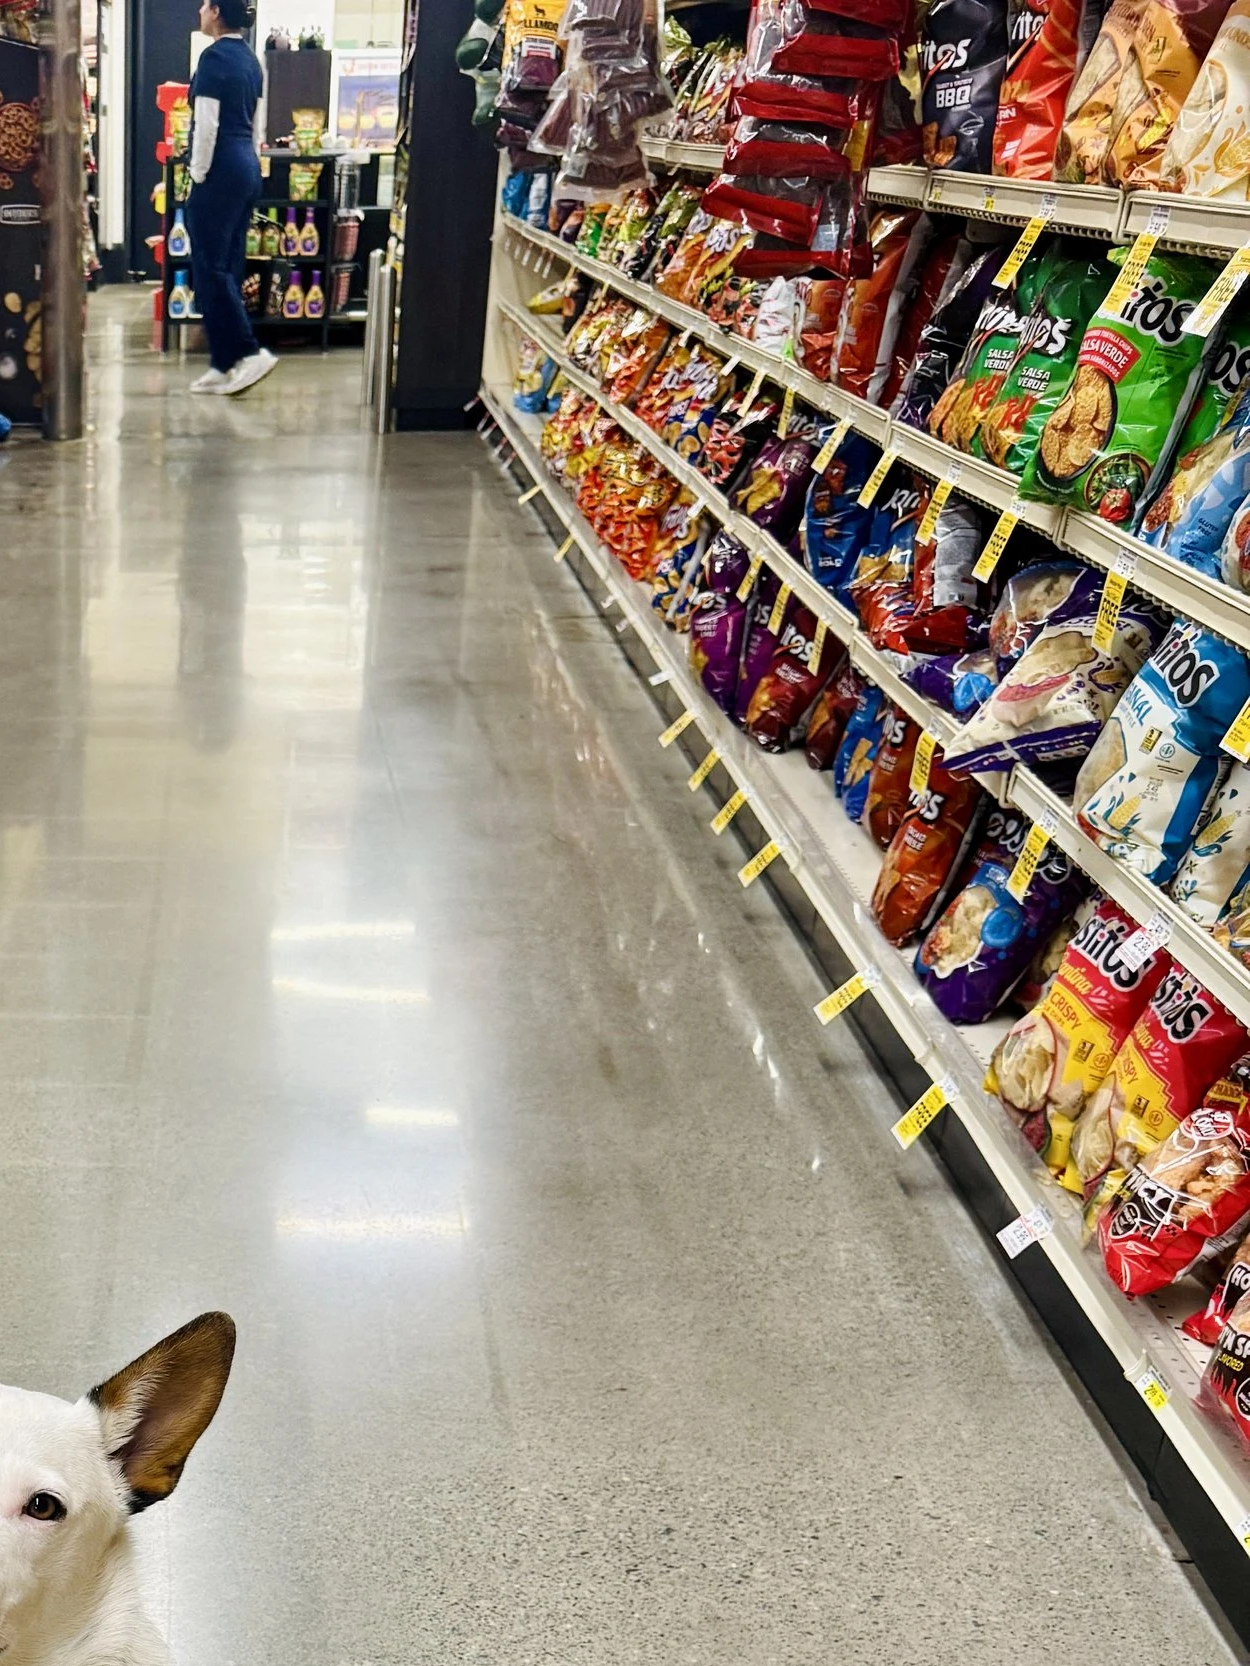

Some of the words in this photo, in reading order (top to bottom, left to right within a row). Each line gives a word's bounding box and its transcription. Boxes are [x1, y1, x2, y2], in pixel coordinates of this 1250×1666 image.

[922, 38, 972, 71] itos
[935, 83, 972, 109] BBQ
[987, 348, 1014, 360] SALSA
[1099, 340, 1129, 369] VERDE
[1017, 377, 1049, 391] VERDE
[1021, 366, 1050, 380] SALSA
[1100, 597, 1121, 629] FREE
[1050, 991, 1082, 1031] CRISPY
[1231, 1265, 1250, 1293] HO
